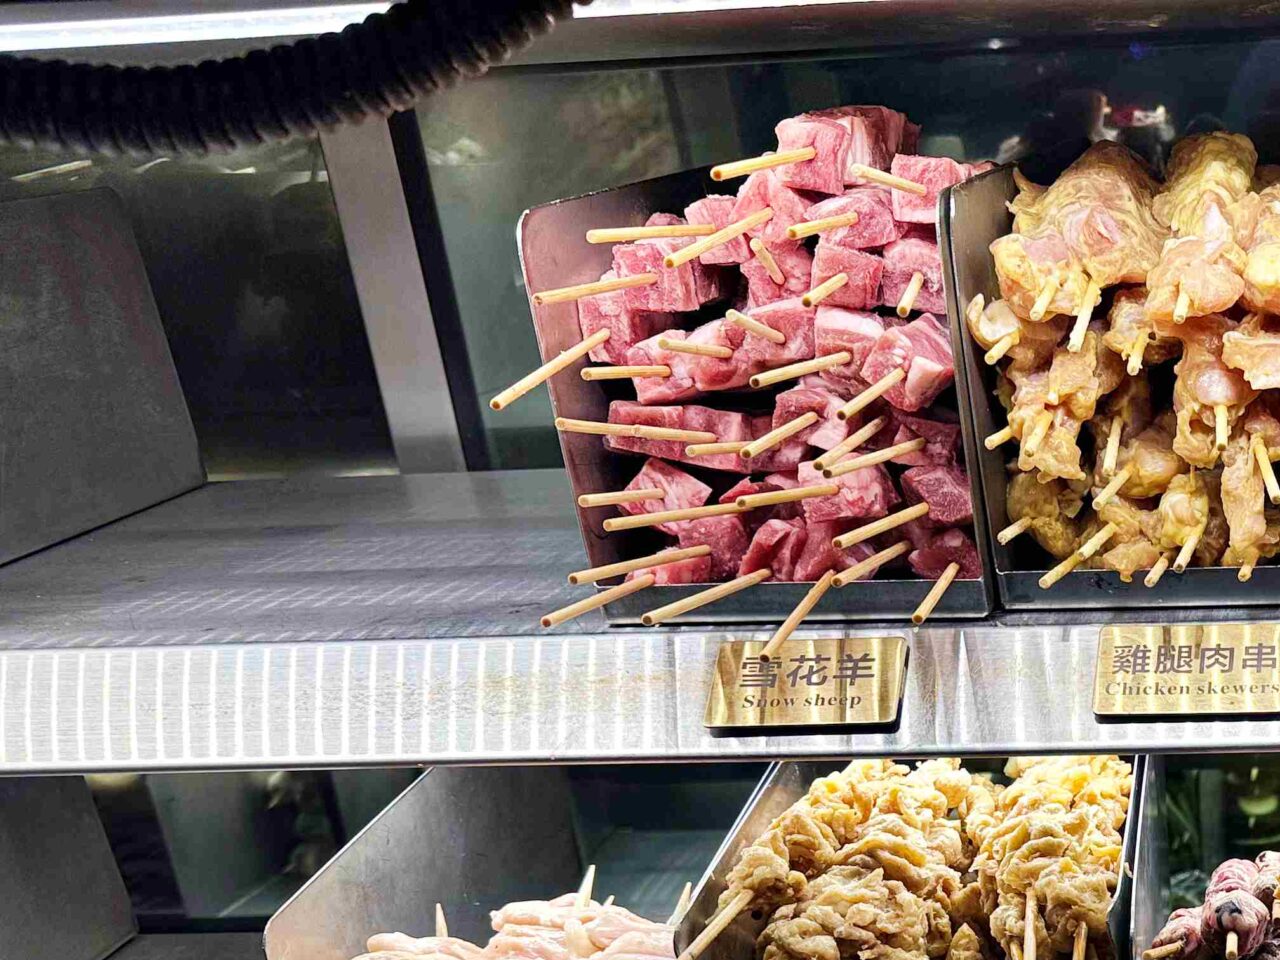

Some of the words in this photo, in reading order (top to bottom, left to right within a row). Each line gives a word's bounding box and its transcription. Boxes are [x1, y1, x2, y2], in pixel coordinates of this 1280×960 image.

[739, 652, 876, 689] 雪花羊
[1111, 642, 1277, 675] 雞腿肉串
[1105, 680, 1190, 697] Chicken
[1196, 680, 1280, 696] skewers
[741, 694, 799, 709] Snow
[803, 693, 862, 710] sheep
